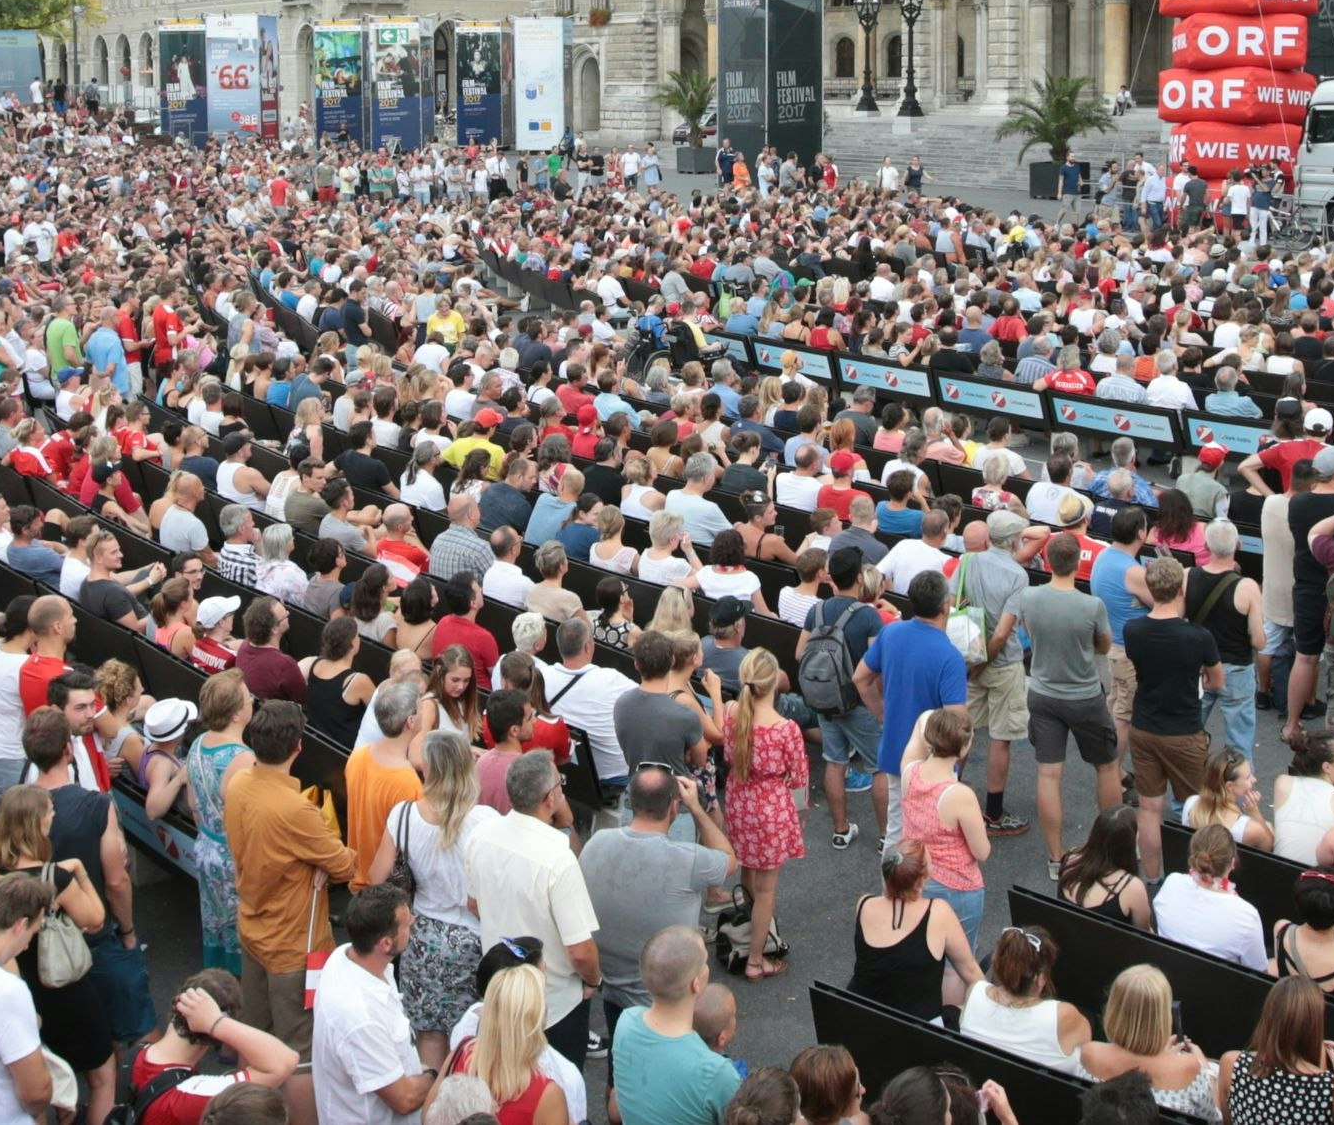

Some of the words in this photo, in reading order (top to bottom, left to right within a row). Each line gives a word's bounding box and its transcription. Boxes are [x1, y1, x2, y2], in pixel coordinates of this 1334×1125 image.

[1197, 26, 1299, 56] ORF
[725, 71, 743, 88] FILM
[776, 70, 797, 88] FILM
[726, 87, 760, 105] FESTIVAL
[777, 86, 816, 105] FESTIVAL
[1162, 79, 1245, 109] ORF
[1257, 86, 1283, 104] WIE
[727, 104, 752, 119] 2017
[778, 104, 806, 119] 2017
[1170, 134, 1187, 163] RF
[1196, 141, 1240, 160] WIE
[1246, 144, 1296, 162] WIR.
